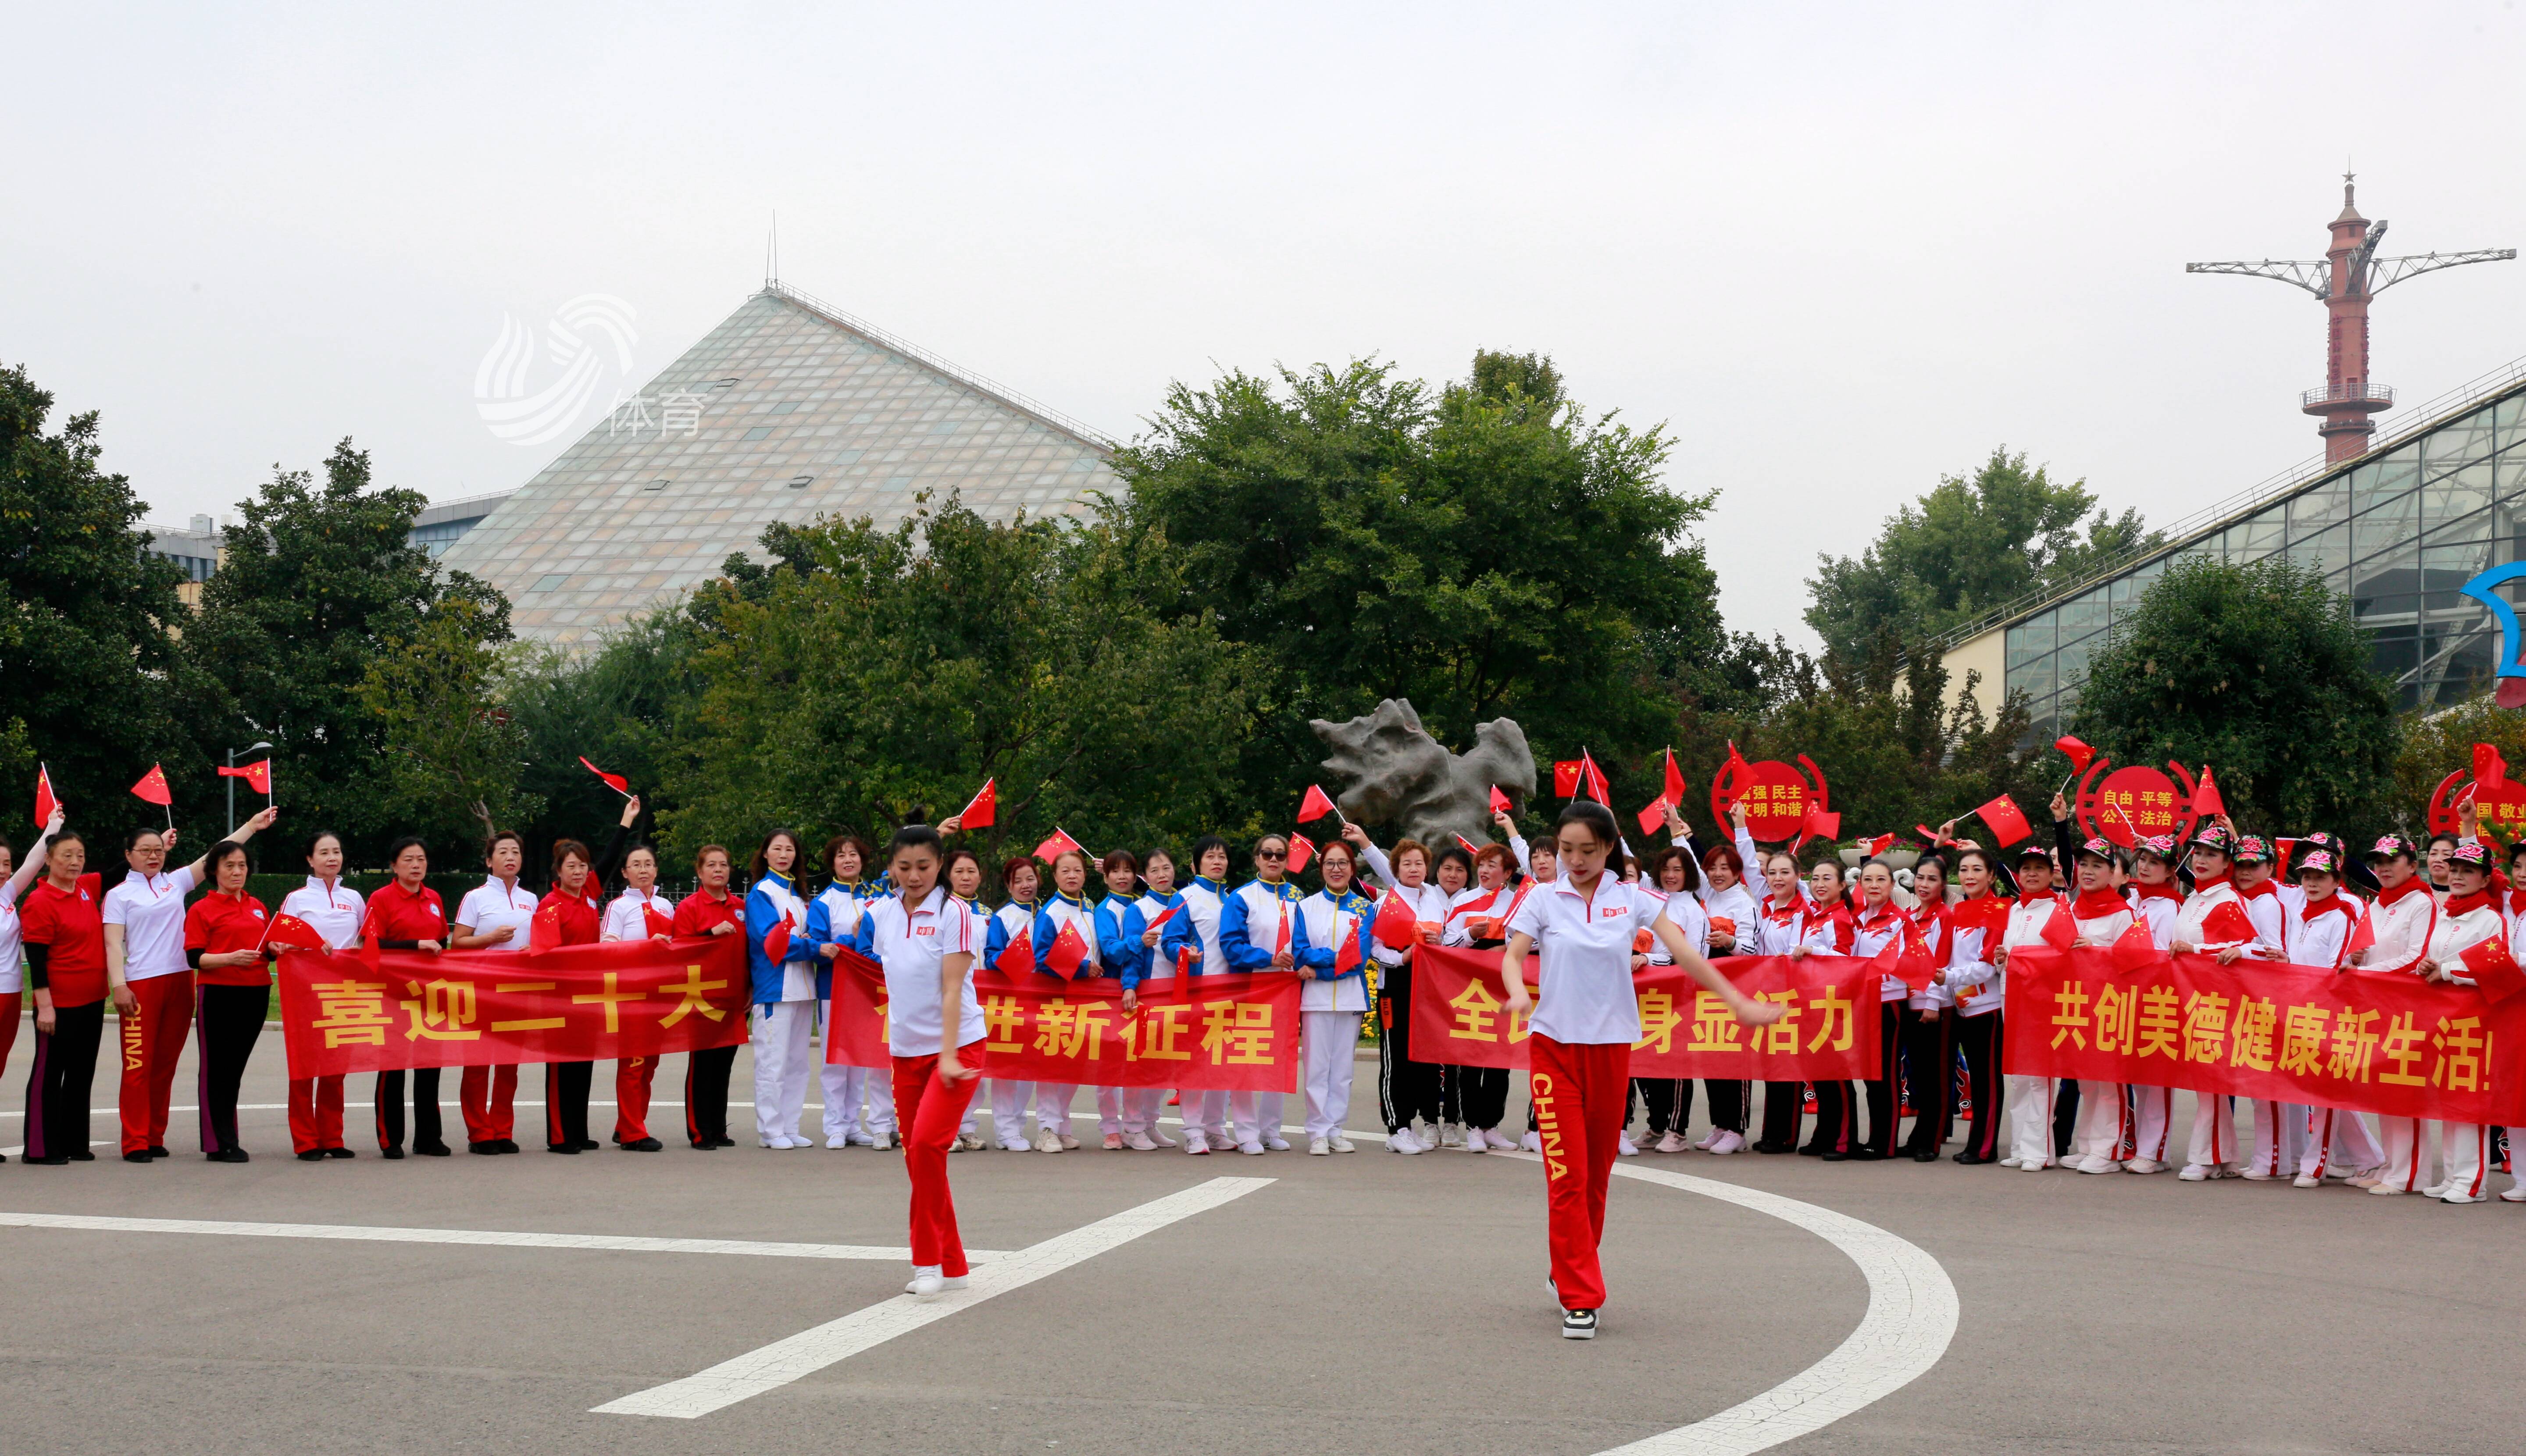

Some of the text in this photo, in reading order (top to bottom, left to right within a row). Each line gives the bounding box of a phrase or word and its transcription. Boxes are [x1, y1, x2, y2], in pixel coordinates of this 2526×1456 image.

[1772, 785, 1802, 800] 民主
[2104, 789, 2173, 807] 自由 平等
[1773, 802, 1802, 817] 和谐
[2140, 810, 2172, 826] 法治
[1606, 907, 1625, 917] 中国
[311, 965, 728, 1049] 喜迎二十大
[1449, 978, 1853, 1055] 全身显活力
[874, 986, 1274, 1066] 进新征程
[1533, 1073, 1567, 1181] CHINA
